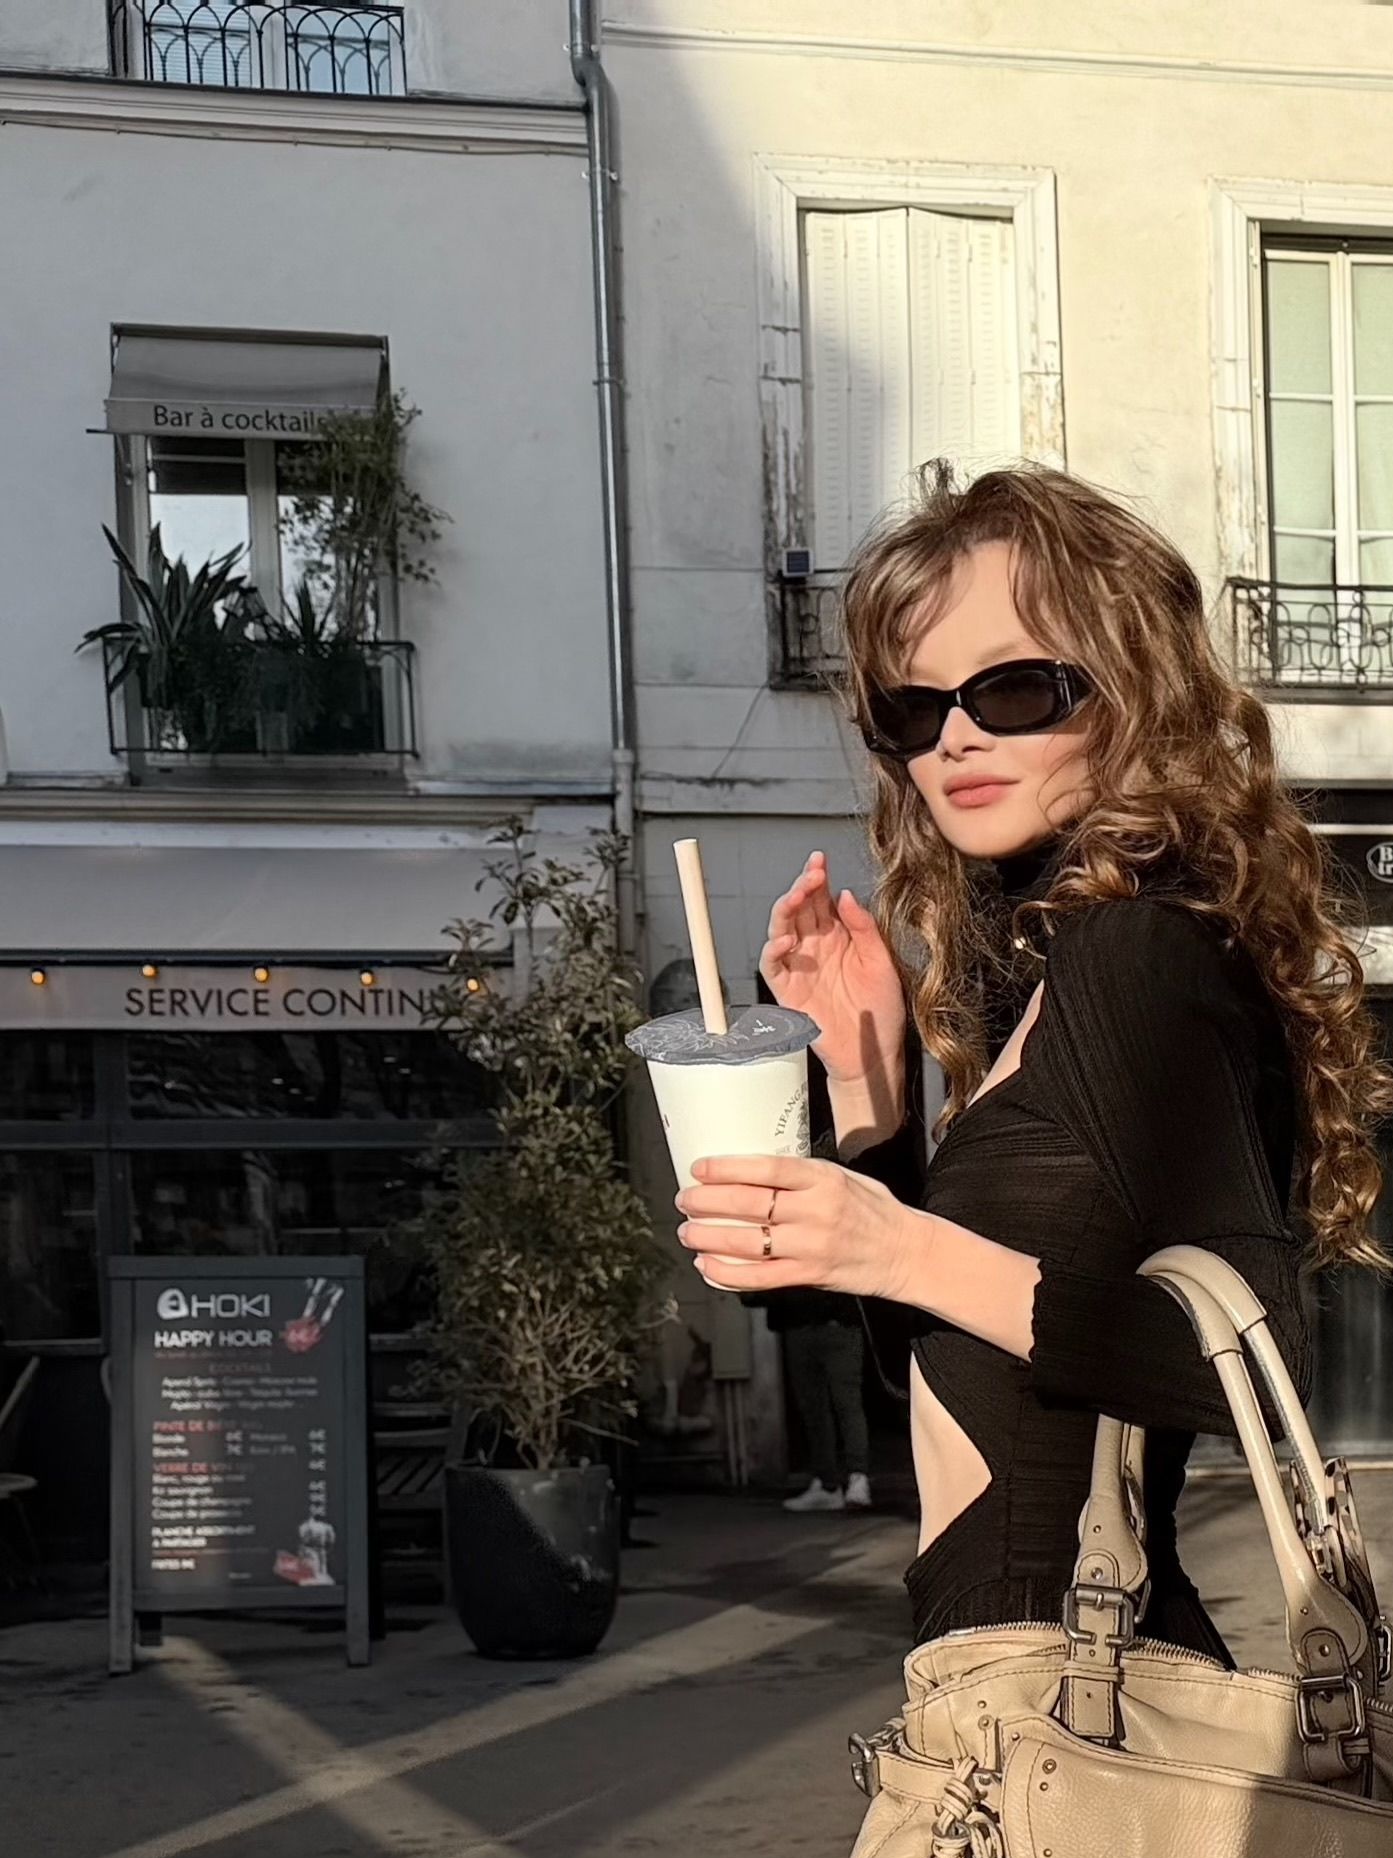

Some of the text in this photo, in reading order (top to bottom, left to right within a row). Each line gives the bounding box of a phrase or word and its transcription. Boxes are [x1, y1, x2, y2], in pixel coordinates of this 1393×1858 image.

[153, 405, 193, 427] Bar
[200, 408, 214, 428] à
[125, 988, 270, 1016] SERVICE
[774, 1088, 802, 1137] YIFANG
[191, 1293, 271, 1319] HOKI
[154, 1330, 215, 1348] HAPPY
[218, 1329, 273, 1347] HOUR
